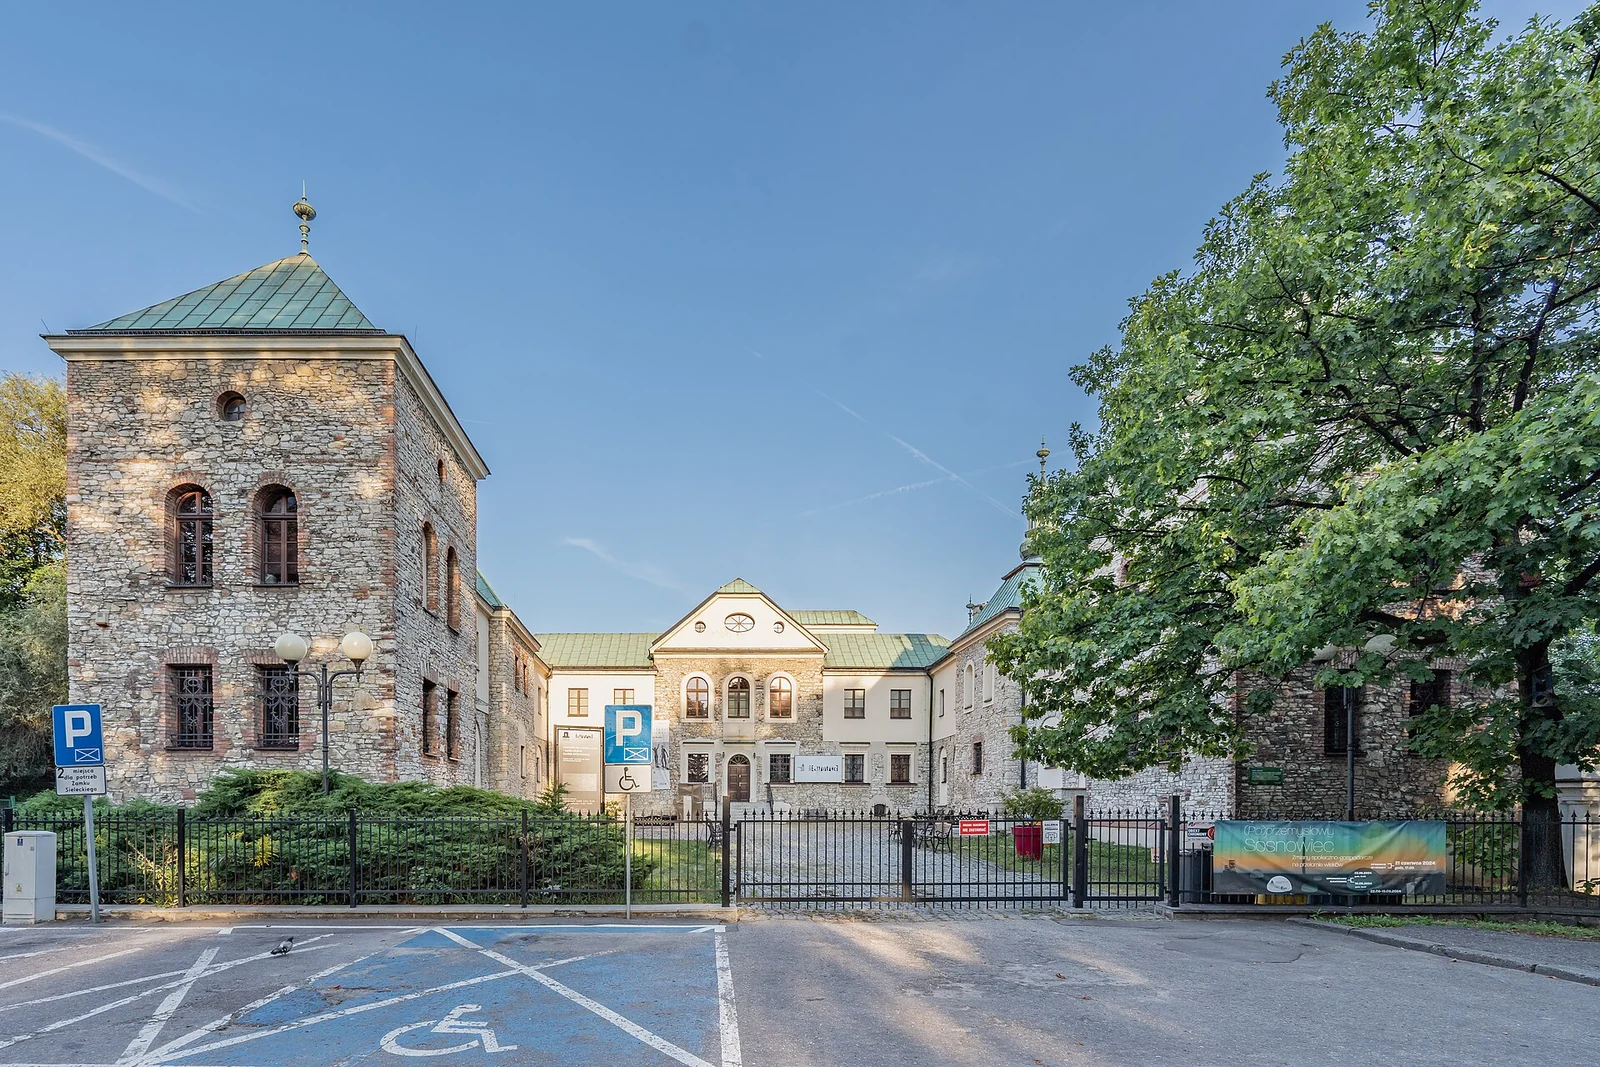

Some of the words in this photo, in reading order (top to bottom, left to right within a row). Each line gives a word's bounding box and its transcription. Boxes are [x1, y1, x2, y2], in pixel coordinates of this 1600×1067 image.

[64, 710, 92, 748] P
[615, 710, 642, 746] P
[57, 767, 65, 779] 2
[1243, 838, 1335, 853] Sosnowiec
